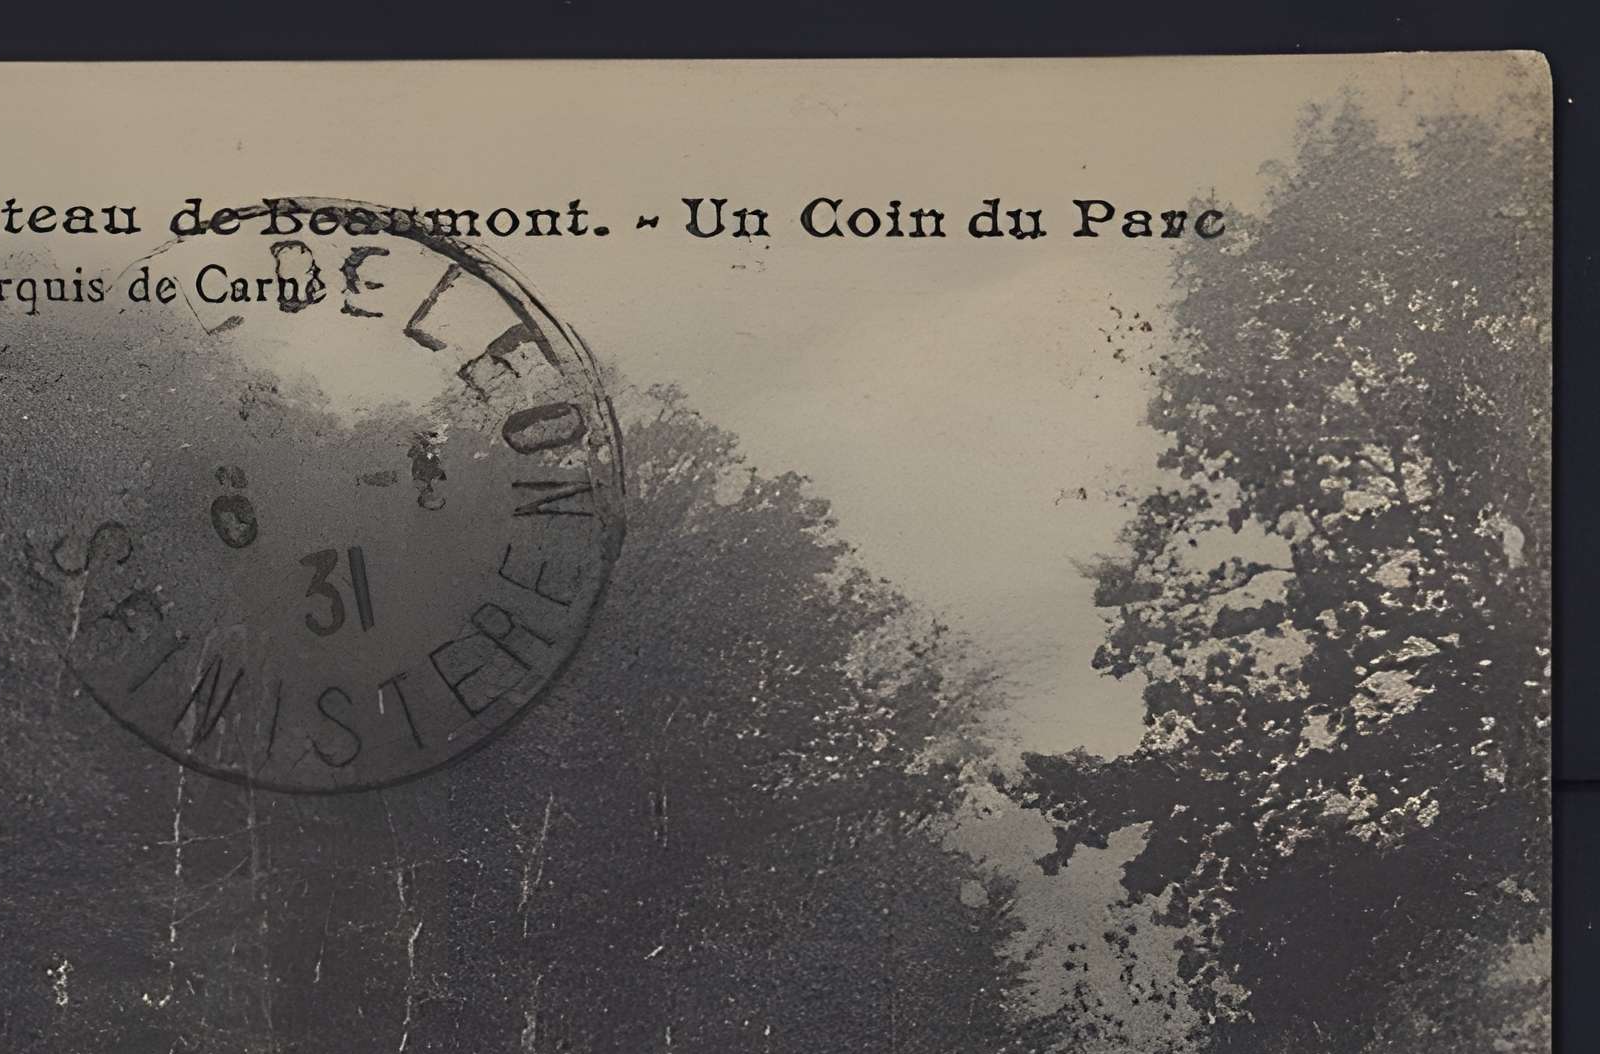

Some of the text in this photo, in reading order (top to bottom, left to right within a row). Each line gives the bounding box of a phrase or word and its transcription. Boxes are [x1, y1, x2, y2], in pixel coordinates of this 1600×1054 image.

[169, 198, 242, 236] de
[682, 198, 770, 239] Un
[800, 198, 945, 239] Coin
[968, 198, 1047, 239] du
[1072, 199, 1227, 239] Parc
[128, 266, 177, 303] de
